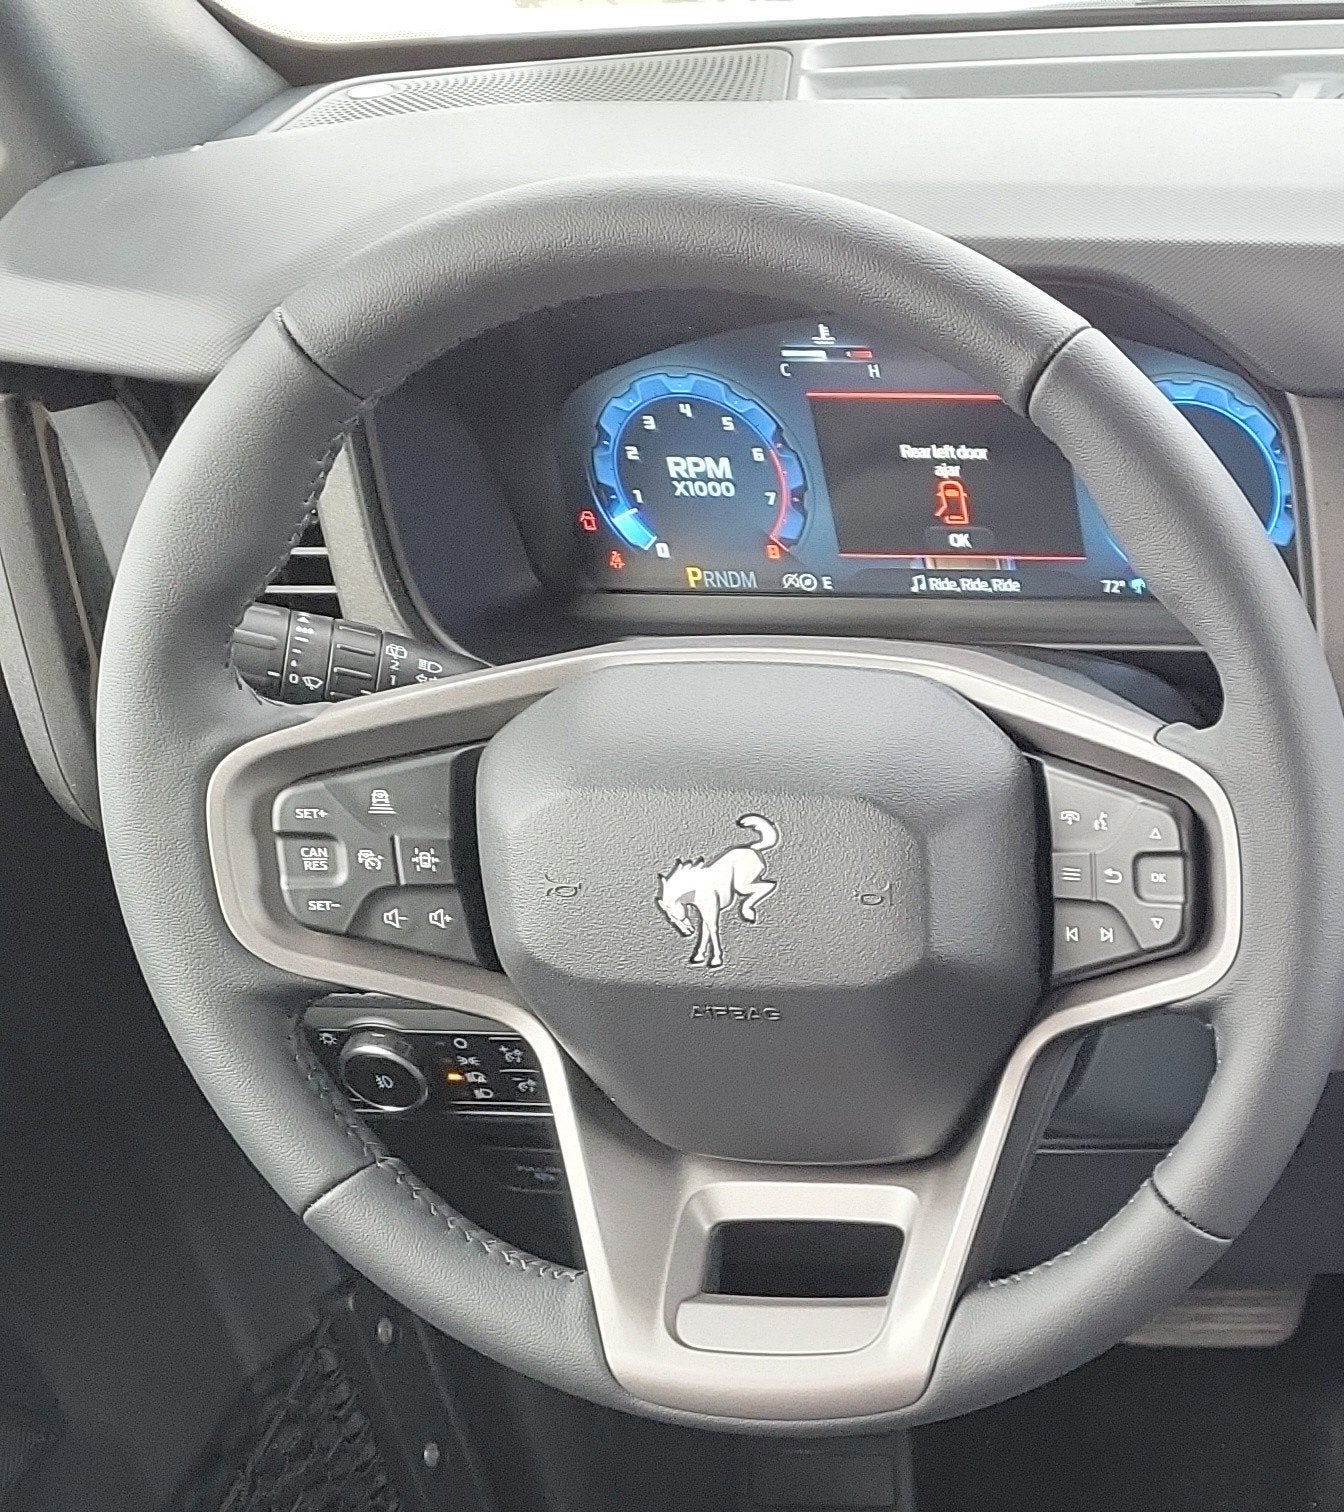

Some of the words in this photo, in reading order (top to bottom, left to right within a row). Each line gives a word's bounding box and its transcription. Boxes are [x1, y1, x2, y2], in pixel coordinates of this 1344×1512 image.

[780, 363, 791, 377] C
[868, 364, 880, 378] H
[679, 404, 692, 417] 4
[643, 415, 656, 430] 3
[722, 417, 735, 430] 5
[625, 446, 639, 460] 2
[752, 448, 765, 461] 6
[900, 444, 931, 459] Rear
[933, 444, 954, 459] left
[955, 444, 988, 460] door
[667, 457, 733, 479] RPM
[934, 464, 961, 478] ajar
[672, 481, 736, 497] X1000
[633, 490, 644, 503] 1
[765, 492, 776, 505] 7
[949, 533, 972, 549] OK
[655, 542, 671, 558] 0
[822, 577, 834, 589] E
[993, 578, 1020, 593] Ride
[389, 658, 400, 671] 2
[390, 674, 397, 686] 1
[295, 808, 328, 820] SET+
[300, 846, 328, 859] CAN
[303, 860, 328, 872] RES
[1151, 872, 1167, 883] OK
[689, 1004, 781, 1023] AIRBAG
